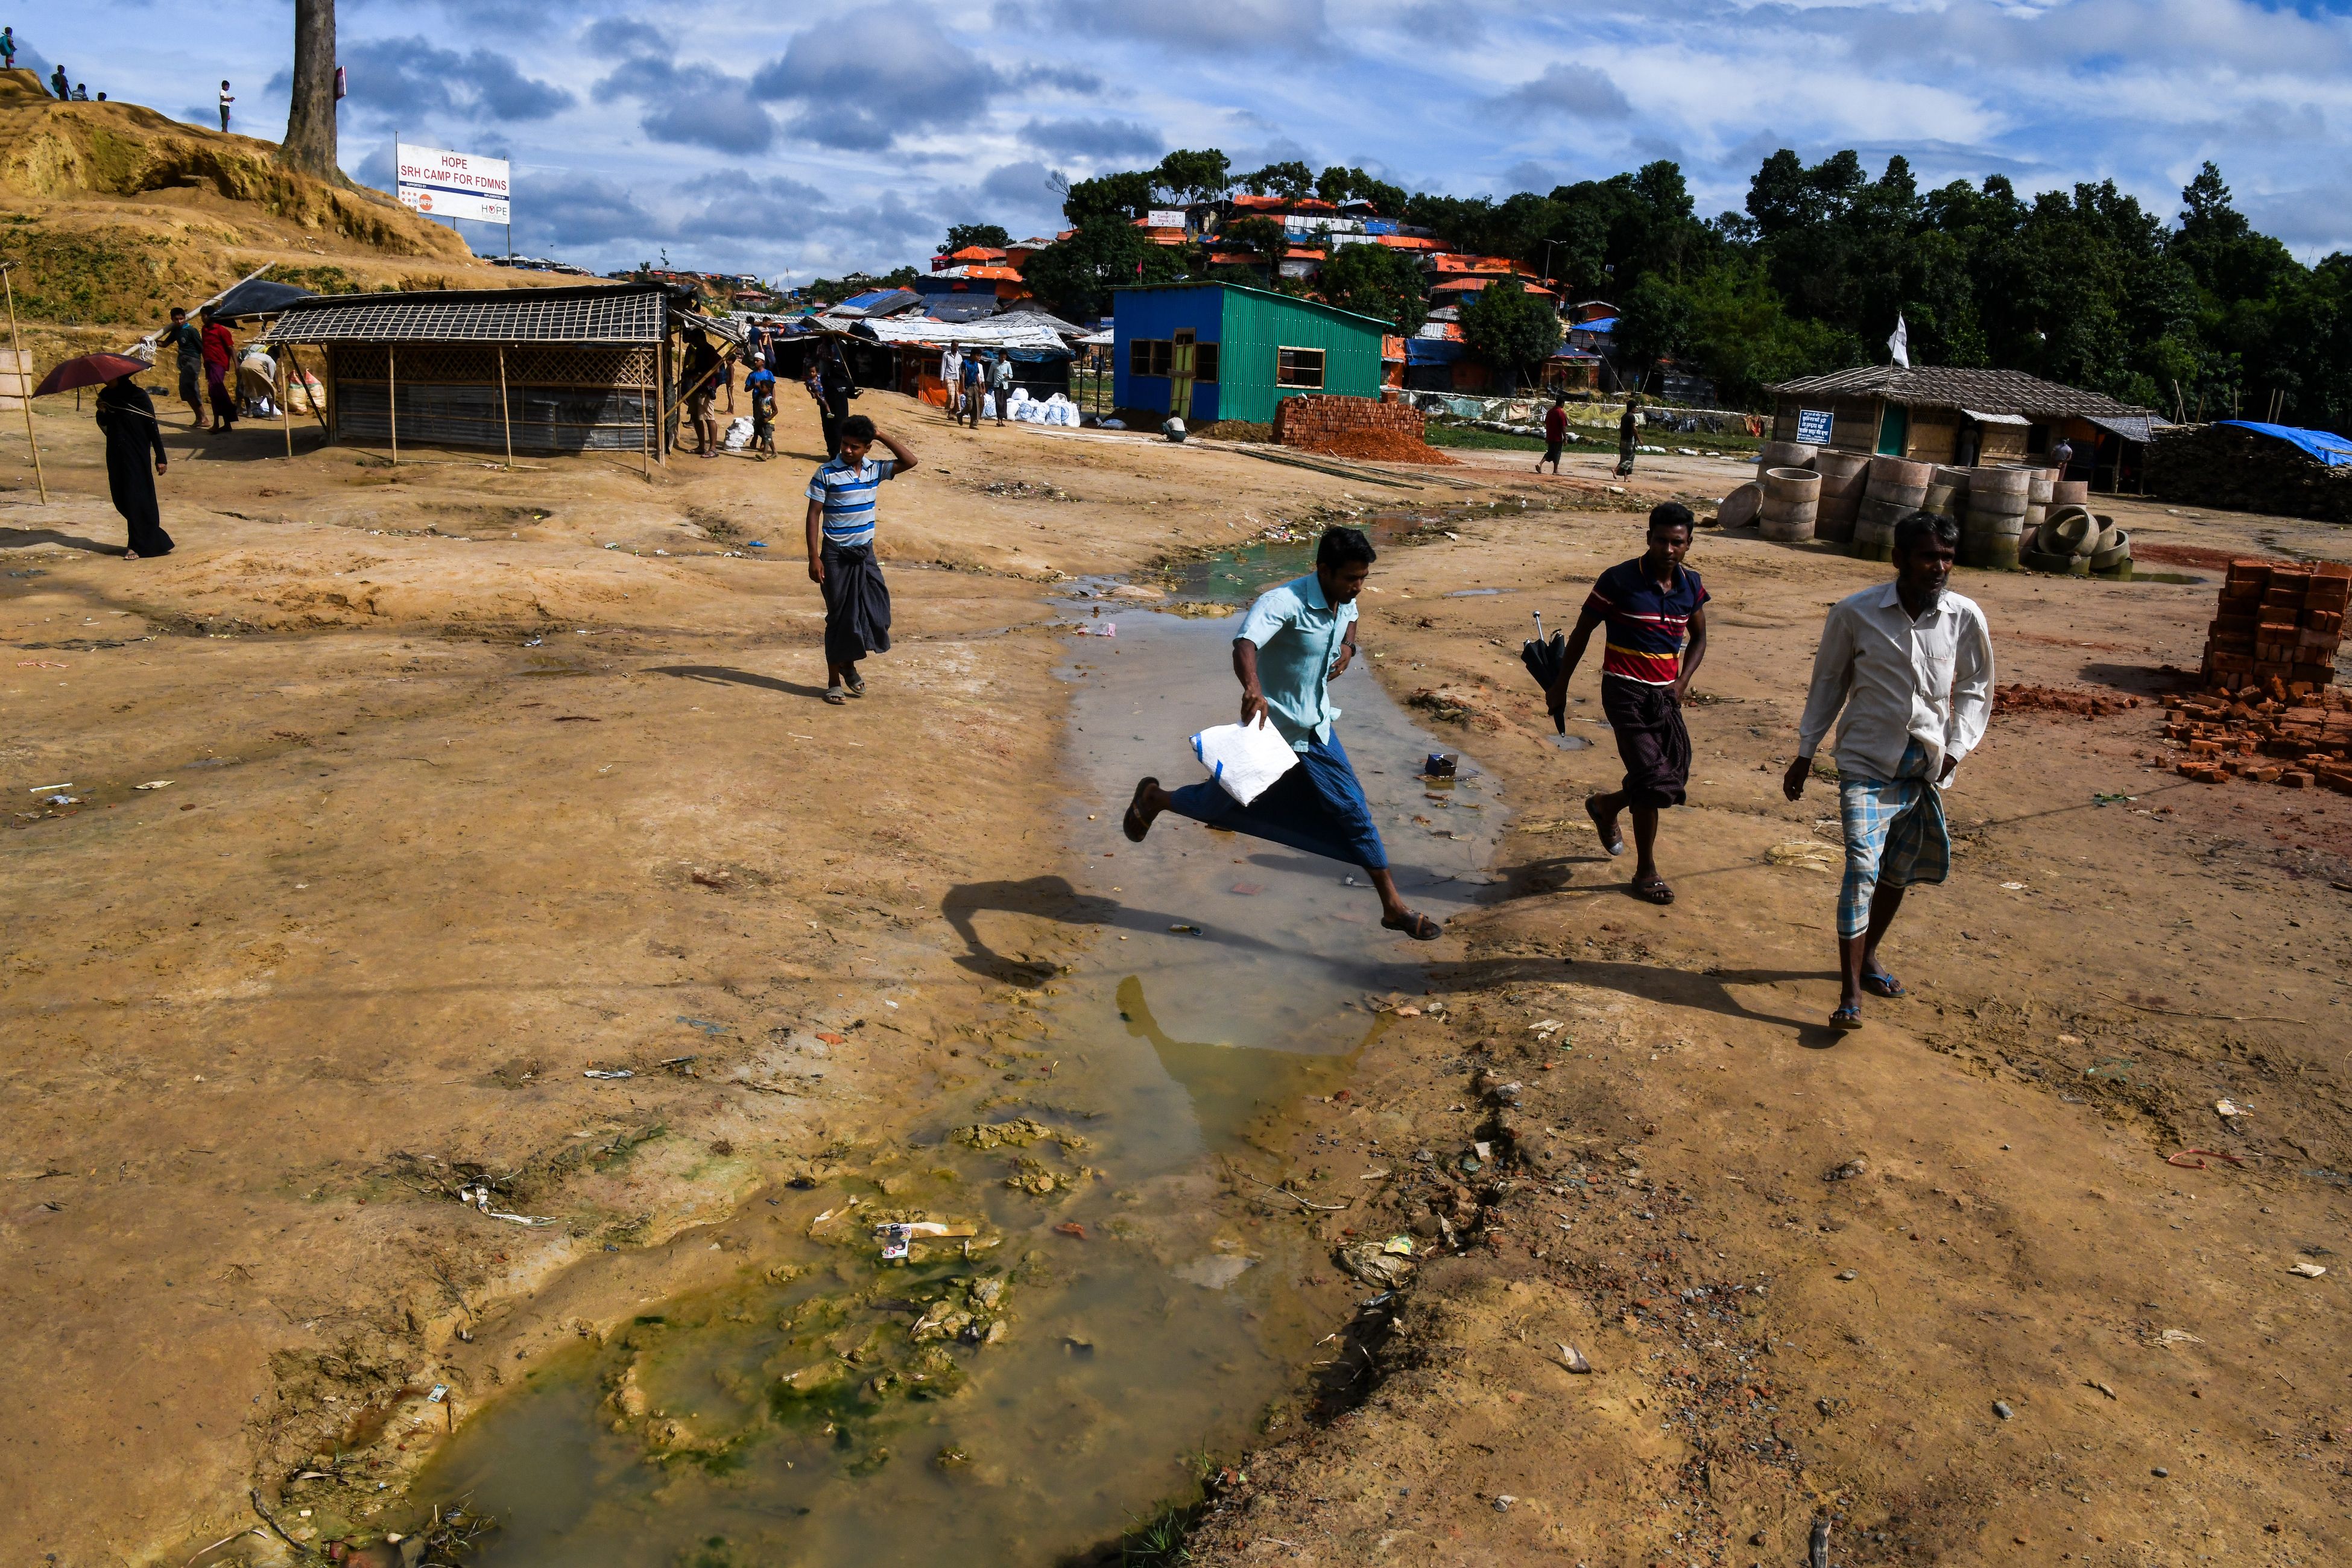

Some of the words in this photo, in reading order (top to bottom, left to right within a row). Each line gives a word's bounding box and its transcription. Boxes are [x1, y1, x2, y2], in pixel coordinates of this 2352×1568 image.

[441, 156, 467, 169] HOPE
[401, 165, 421, 178] SRH
[423, 168, 450, 182] CAMP
[454, 173, 473, 185] FOR
[476, 177, 507, 191] FDMNS
